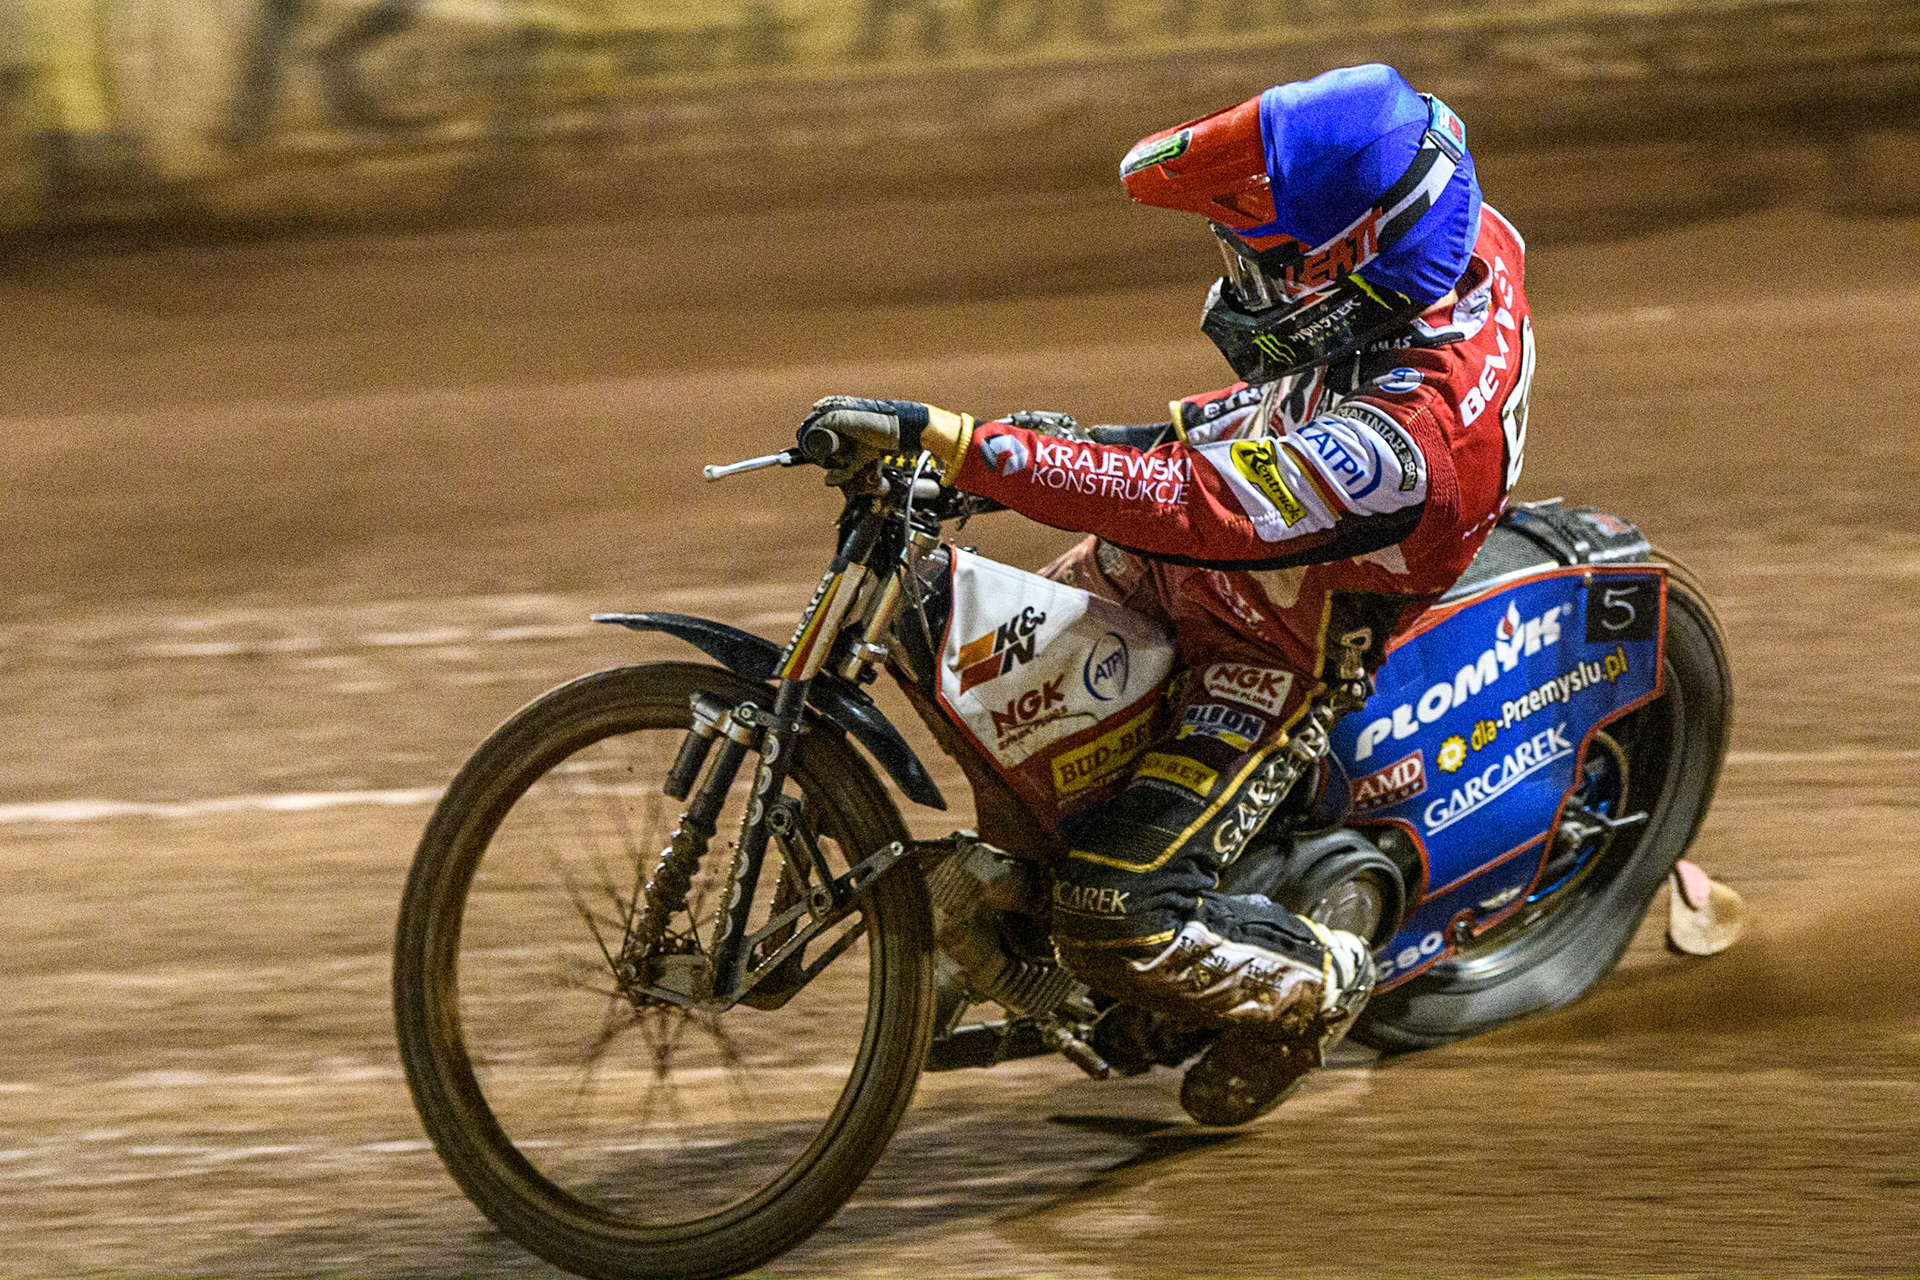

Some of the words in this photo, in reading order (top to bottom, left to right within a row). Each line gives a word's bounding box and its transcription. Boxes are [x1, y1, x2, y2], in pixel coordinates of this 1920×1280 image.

[1286, 206, 1382, 295] LEATT
[1035, 443, 1192, 483] KRAJEWSKI
[1306, 431, 1365, 487] ATPI
[1031, 465, 1190, 506] KONSTRUKCJE
[1601, 586, 1640, 630] 5
[1212, 666, 1286, 698] NGK
[1355, 604, 1563, 762] PŁOMYK
[990, 673, 1066, 739] NGK
[1356, 758, 1422, 801] AMD
[1423, 722, 1572, 828] GARCAREK
[1053, 880, 1131, 914] CAREK
